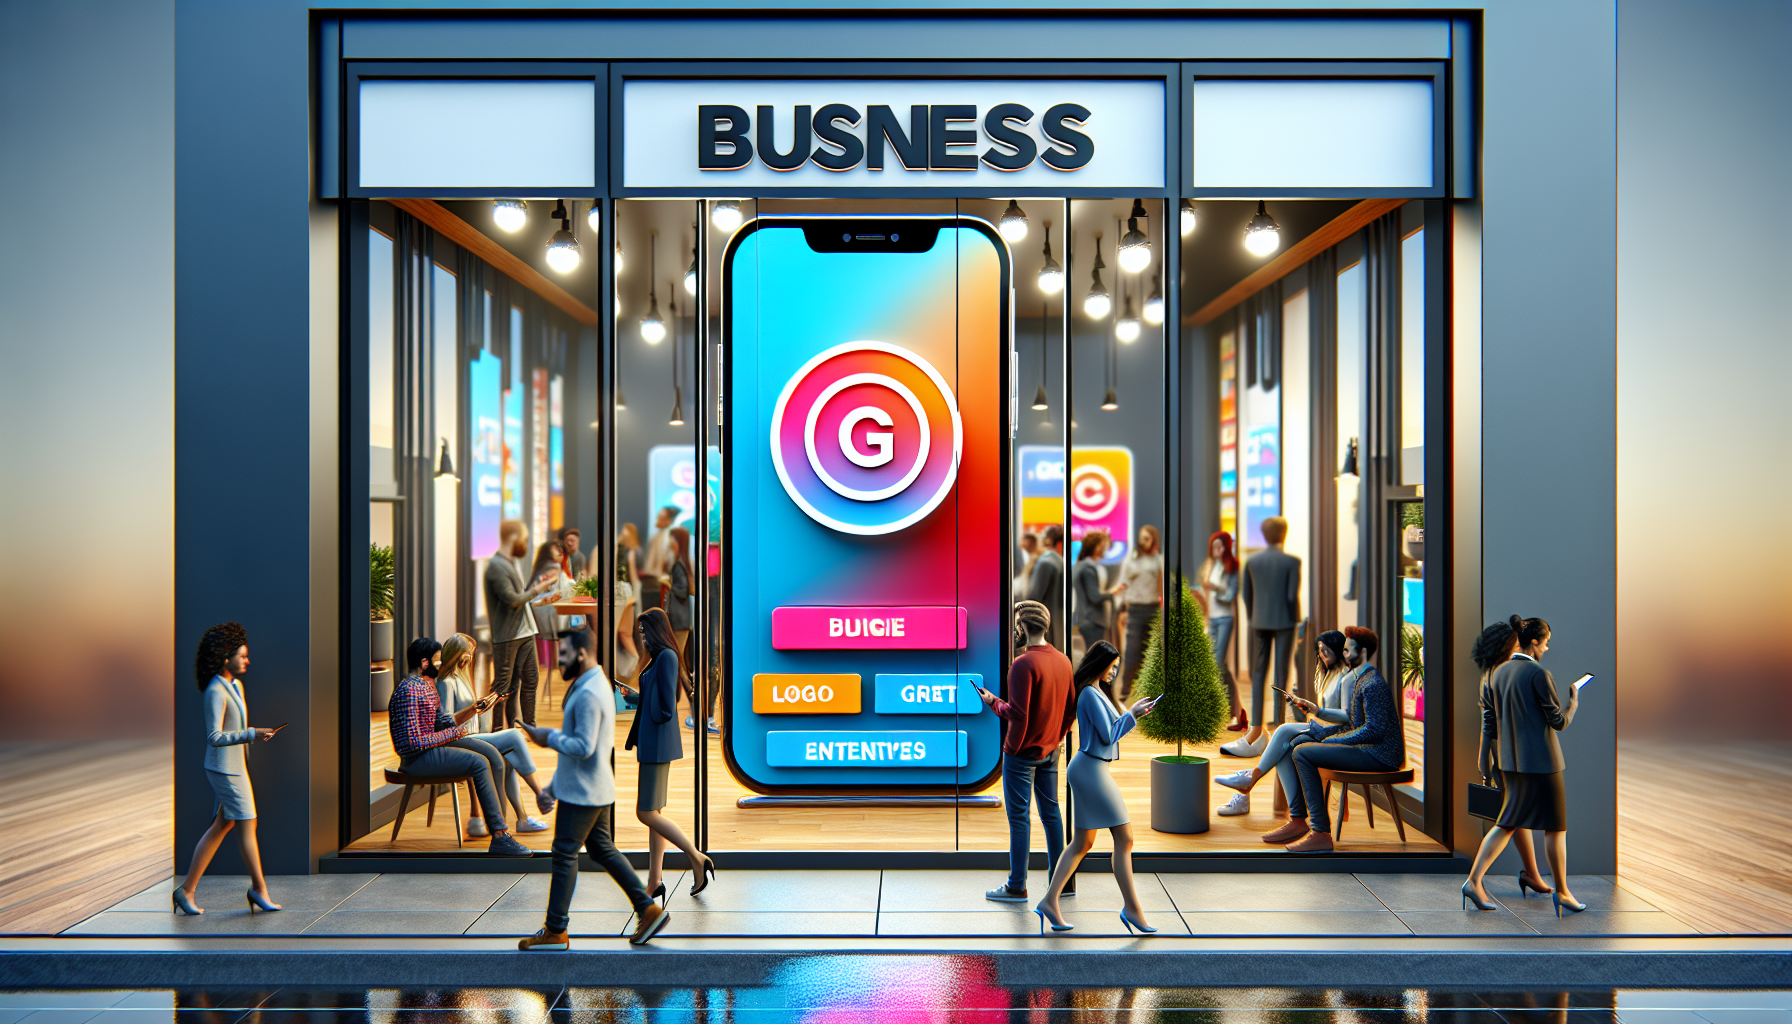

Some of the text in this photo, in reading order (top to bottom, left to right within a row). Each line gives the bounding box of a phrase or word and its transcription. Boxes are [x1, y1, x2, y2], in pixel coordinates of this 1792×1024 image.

[697, 103, 1095, 172] BUSNESS
[838, 405, 894, 468] G
[772, 685, 834, 703] LOGO
